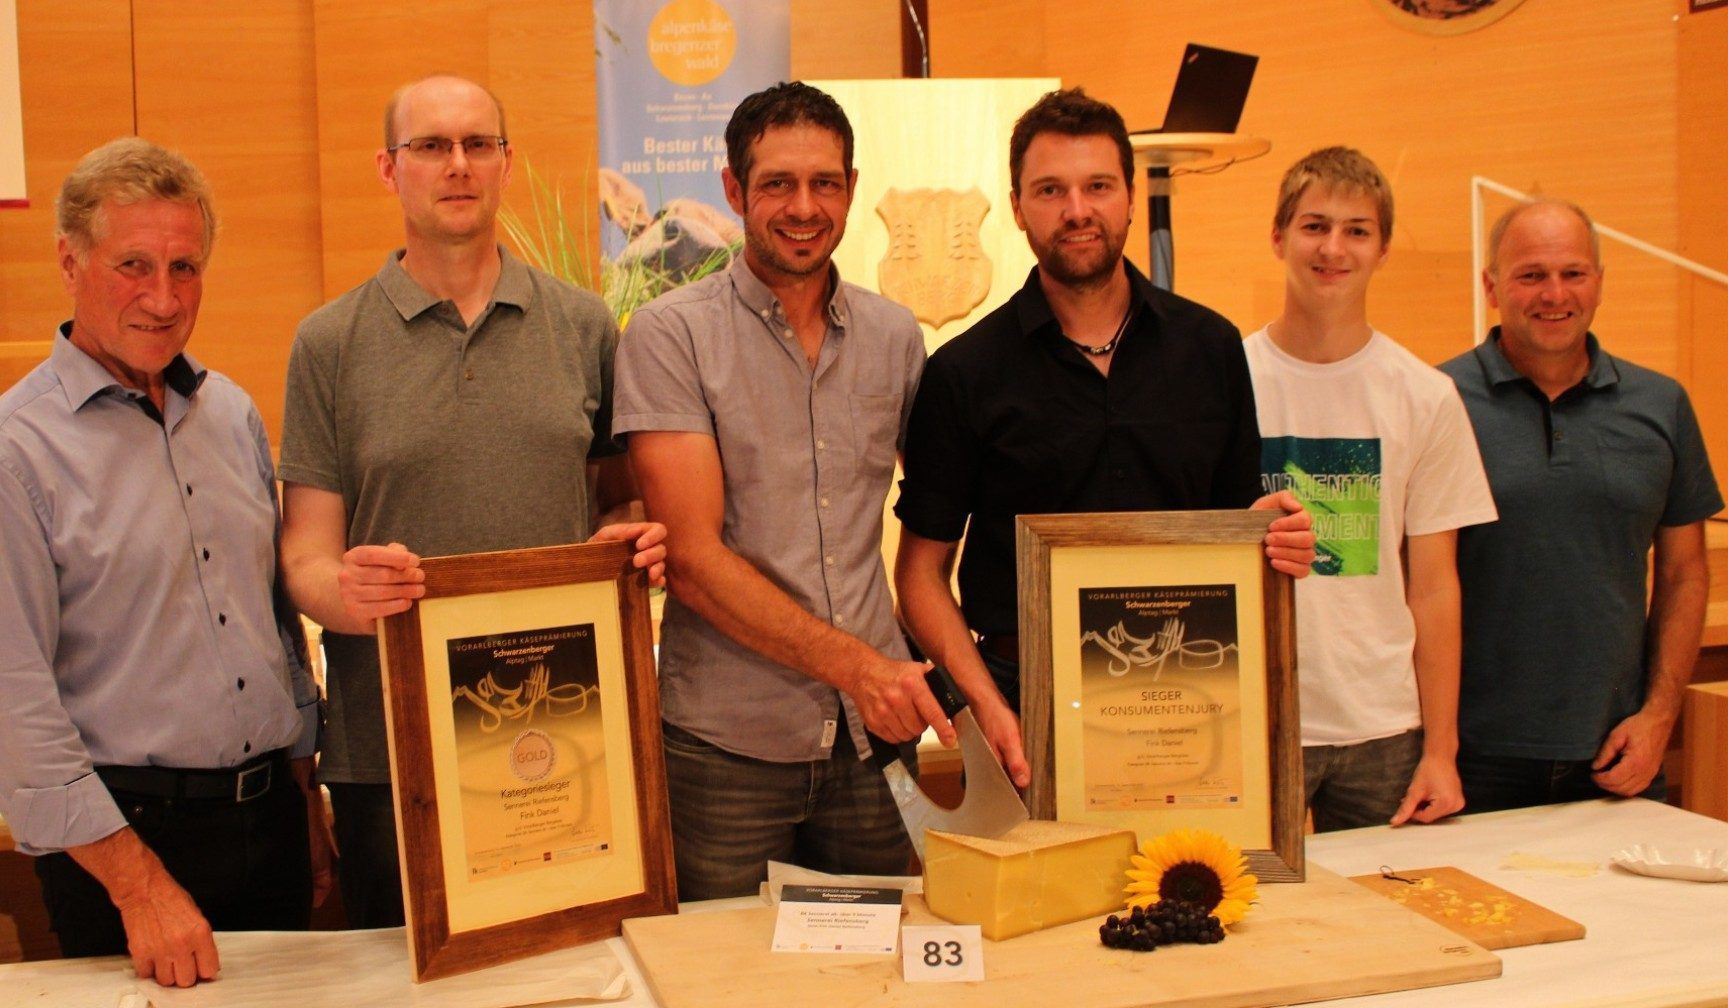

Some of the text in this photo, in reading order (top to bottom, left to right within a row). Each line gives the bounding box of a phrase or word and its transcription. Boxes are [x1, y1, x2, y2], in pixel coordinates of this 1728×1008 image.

[643, 136, 697, 154] Bester
[622, 161, 651, 174] aus
[656, 158, 708, 174] bester
[1089, 591, 1151, 600] VORARLBERGER
[1125, 601, 1191, 609] Schwarzenberger
[455, 638, 517, 652] VORARLBERGER
[493, 644, 555, 659] Schwarzenberger
[1141, 691, 1183, 701] SIEGER
[1100, 704, 1224, 717] KONSUMENTENJURY
[516, 750, 548, 764] GOLD
[501, 780, 571, 799] Kategoriesieger
[520, 806, 560, 820] Fink Daniel
[924, 941, 963, 967] 83
